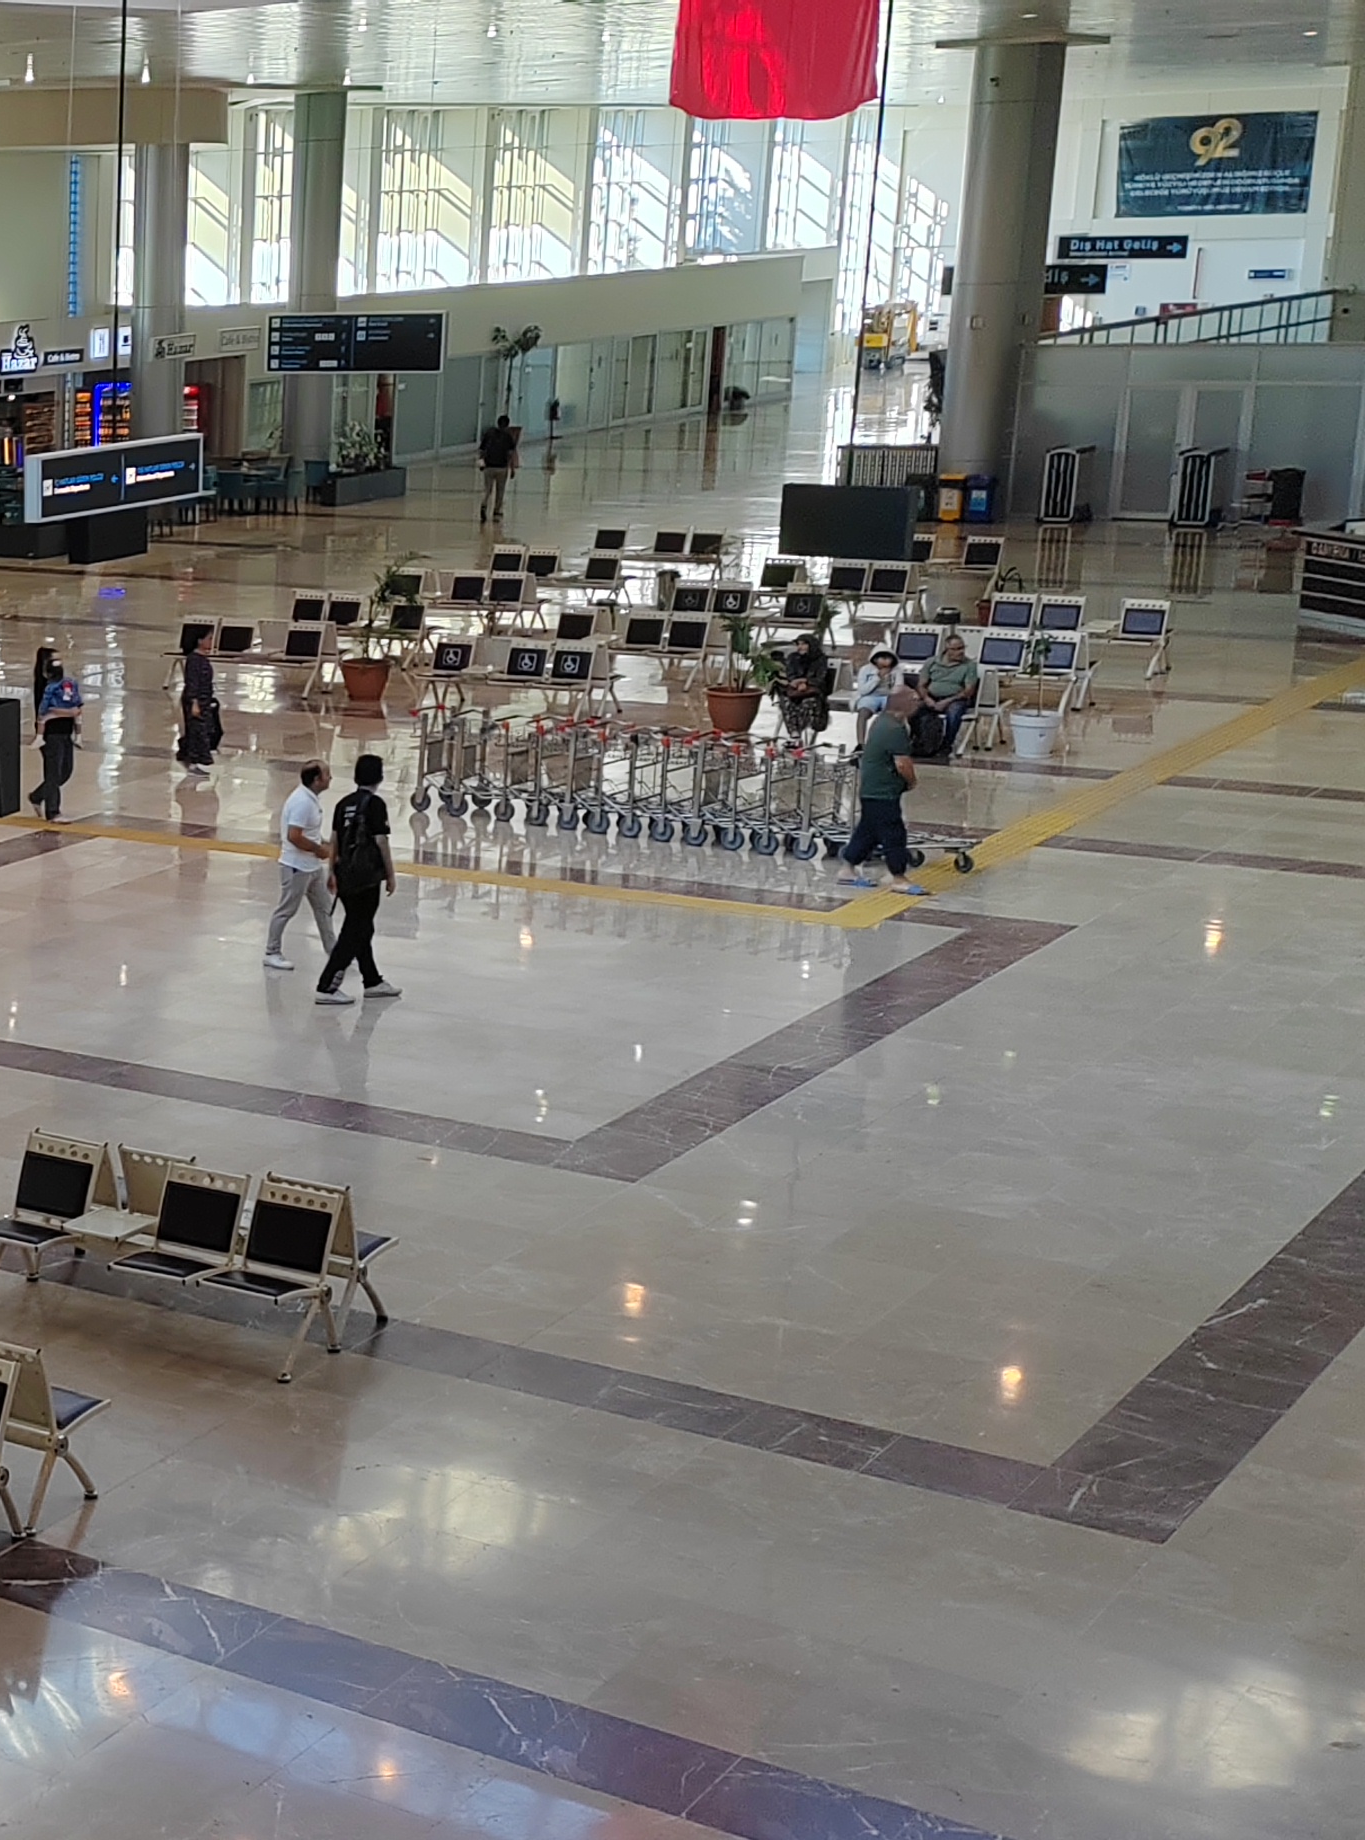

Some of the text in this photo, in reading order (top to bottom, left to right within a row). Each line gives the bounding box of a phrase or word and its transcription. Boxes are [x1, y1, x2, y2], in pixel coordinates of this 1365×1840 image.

[1189, 117, 1243, 167] 92
[1070, 239, 1158, 251] Dış Hat Geliş
[1, 354, 38, 372] Hazar
